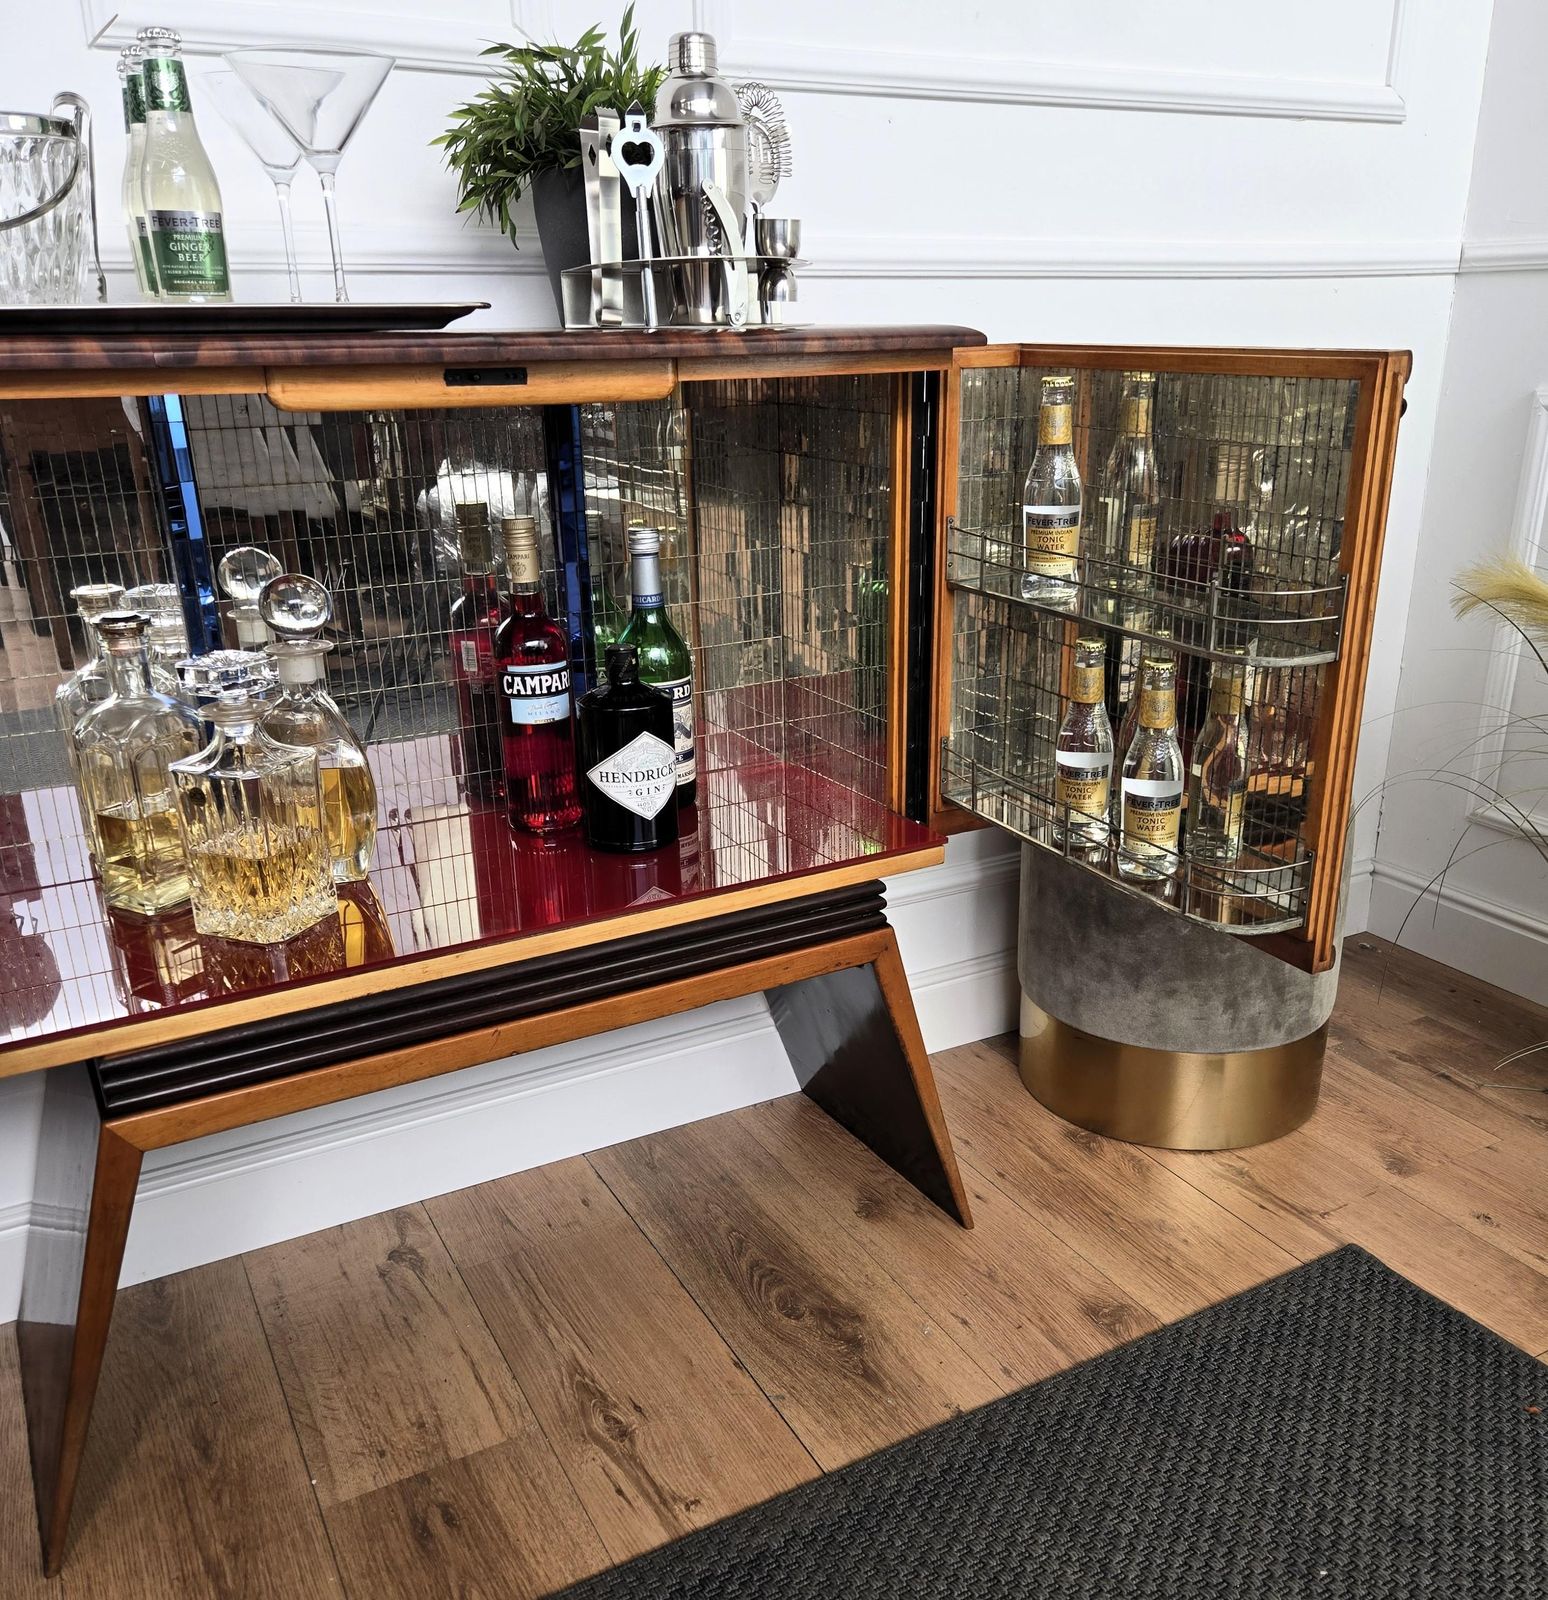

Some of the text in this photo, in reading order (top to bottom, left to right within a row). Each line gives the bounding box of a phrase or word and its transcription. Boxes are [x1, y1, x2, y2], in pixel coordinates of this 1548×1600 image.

[152, 216, 221, 229] FEVER-TREE
[169, 242, 212, 252] GINGER
[178, 253, 207, 262] BEER
[1027, 516, 1077, 527] FEVER-TREE
[1037, 543, 1065, 551] WATER
[502, 668, 571, 696] CAMPARI
[635, 784, 661, 797] GIN
[1065, 785, 1092, 794] TONIC
[1065, 792, 1092, 800] WATER
[1126, 796, 1180, 809] FEVER-TREE
[1130, 809, 1154, 818] PREMIUM
[1137, 817, 1166, 825] TONIC
[1136, 824, 1166, 832] WATER
